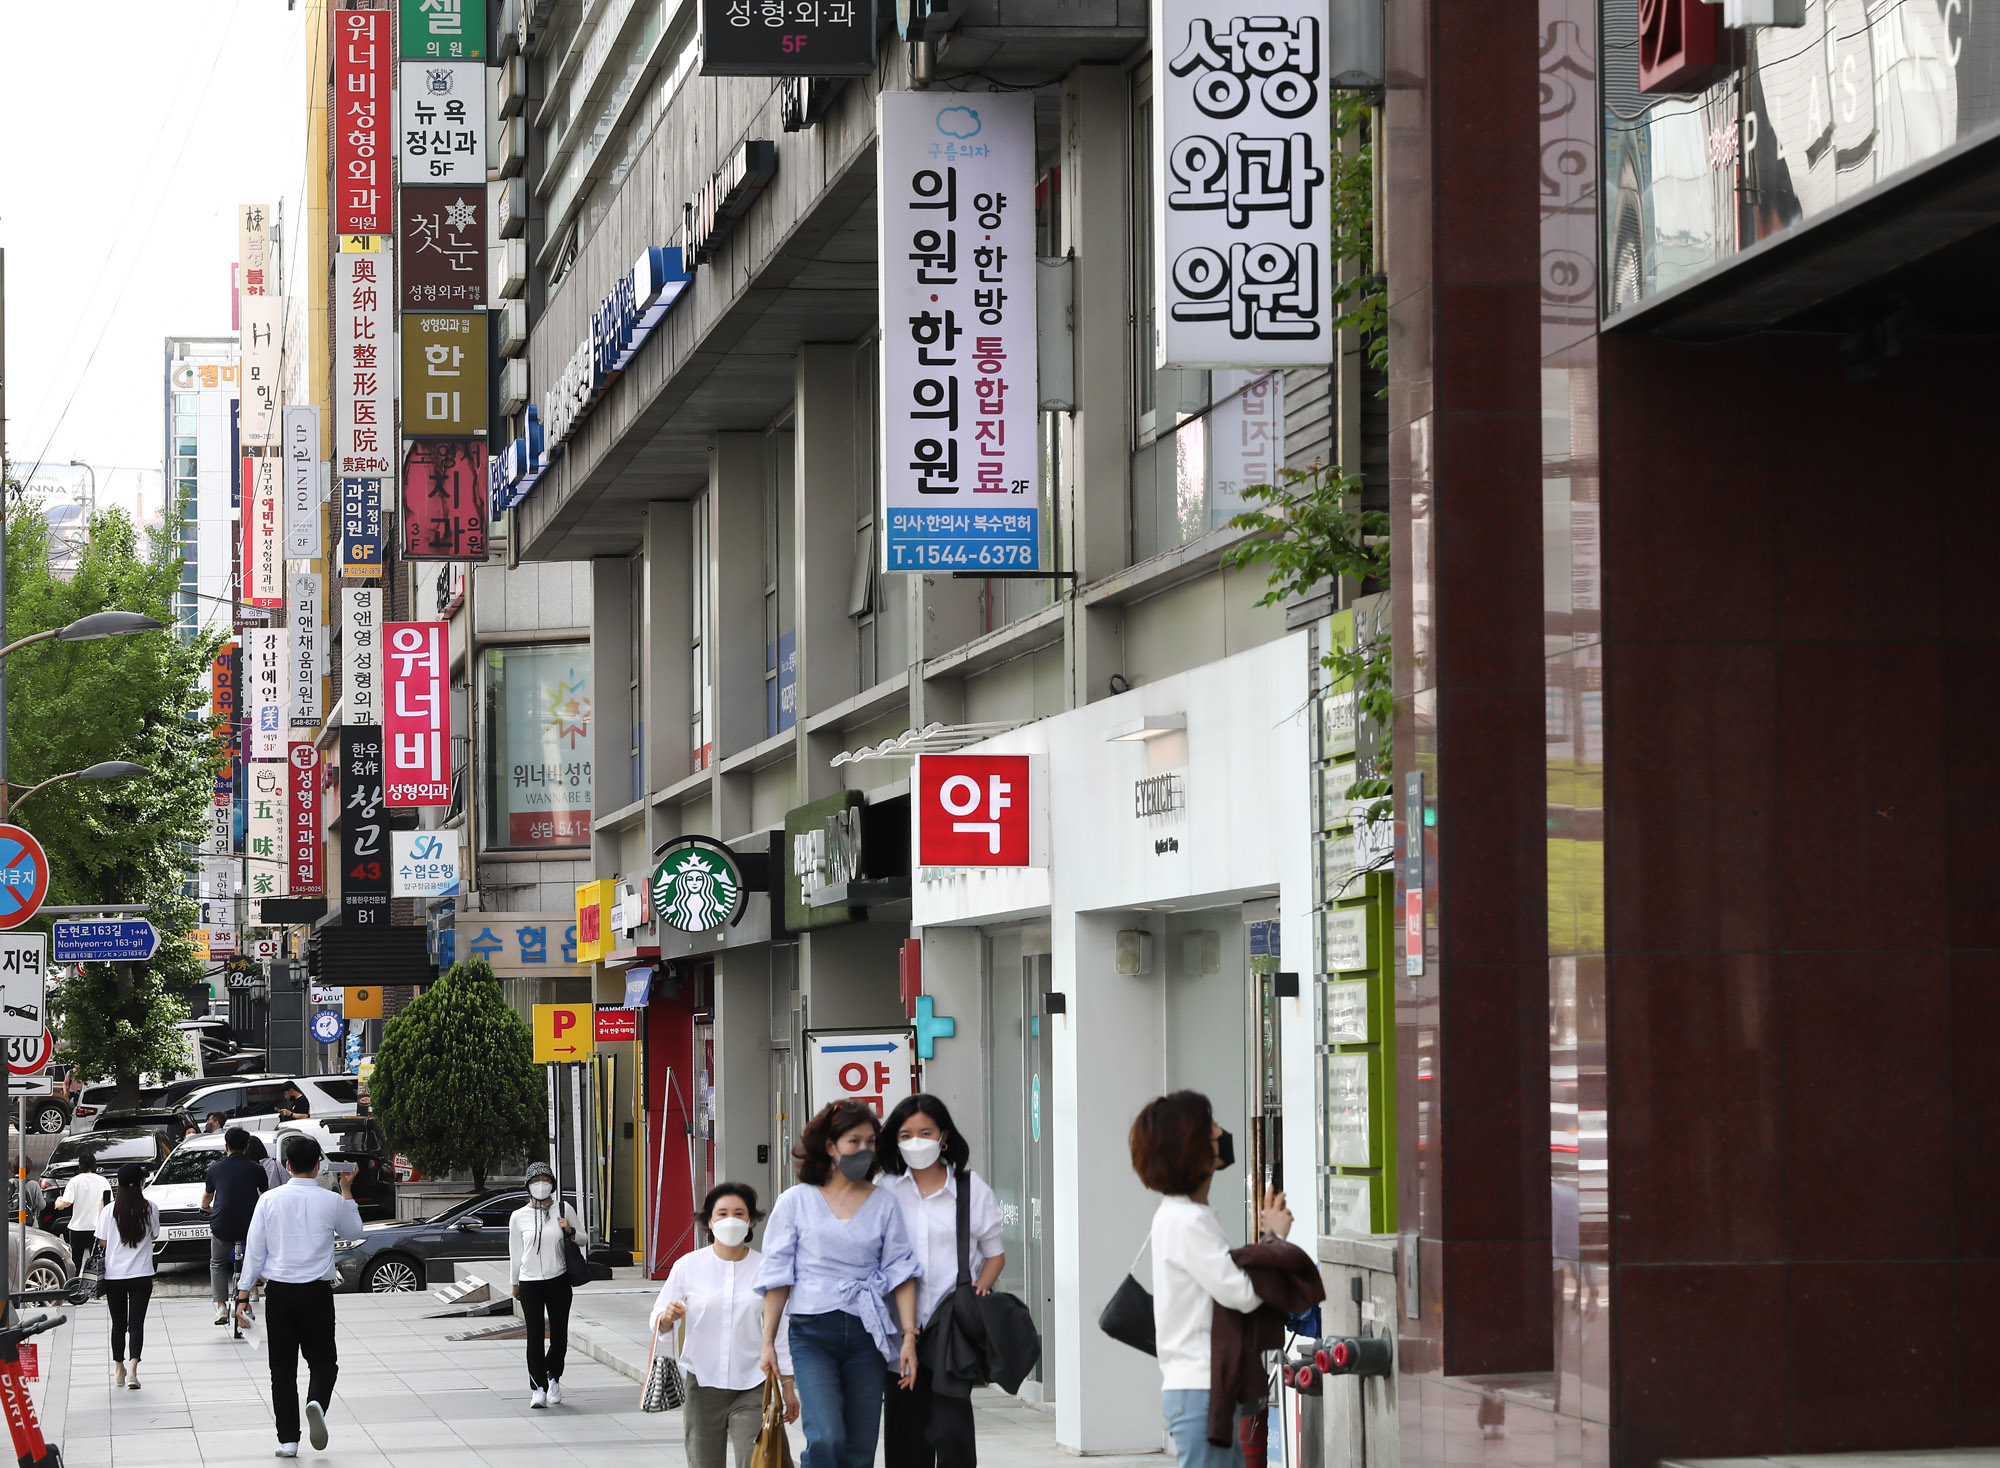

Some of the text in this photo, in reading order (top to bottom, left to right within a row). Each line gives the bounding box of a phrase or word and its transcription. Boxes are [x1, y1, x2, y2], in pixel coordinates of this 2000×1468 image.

[426, 42, 463, 57] 의원
[781, 35, 808, 53] 5F
[1169, 16, 1320, 120] 성형
[346, 15, 381, 215] 워너비성형외과
[414, 101, 467, 125] 뉴욕
[406, 131, 478, 156] 정신과
[927, 141, 991, 162] 구름의자
[429, 160, 455, 177] 5F
[1169, 132, 1325, 230] 외과
[349, 216, 378, 230] 의원
[408, 213, 480, 272] 첫눈
[408, 285, 467, 302] 성형외과
[1171, 242, 1321, 340] 의원
[420, 318, 460, 333] 성형외과
[351, 258, 378, 452] 奥纳比整形医院
[424, 343, 465, 423] 한미
[971, 336, 1009, 494] 통합진료
[296, 424, 307, 443] UP
[343, 457, 390, 473] 贵宾中心
[262, 462, 273, 496] 압구정
[296, 466, 308, 511] POINT
[1011, 480, 1030, 495] 2F
[345, 478, 364, 537] 과의원
[366, 478, 380, 537] 과교정과
[427, 470, 466, 555] 치과
[467, 516, 484, 555] 의원
[972, 514, 1032, 533] 복수면허
[297, 538, 309, 547] 2F
[351, 544, 375, 560] 6F
[892, 544, 1033, 566] T.1544-6378
[262, 539, 273, 585] 성형외과
[298, 600, 314, 704] 리앤채움의원
[353, 591, 374, 725] 영앤영 성형외과
[261, 634, 278, 702] 강남예일
[298, 706, 314, 716] 4F
[390, 627, 442, 781] 워너비
[263, 743, 277, 751] 3F
[351, 742, 379, 759] 한우
[351, 761, 379, 776] 名作
[387, 783, 449, 801] 성형외과
[525, 791, 581, 804] WANNABE
[1135, 772, 1173, 819] EYERICH
[346, 784, 383, 856] 창고
[939, 774, 1012, 855] 약
[529, 821, 554, 839] 상담
[253, 799, 274, 894] 五味家
[409, 835, 443, 860] Sh
[351, 861, 382, 880] 43
[400, 863, 455, 880] 수협은행
[358, 908, 375, 924] B1
[57, 924, 122, 938] 논현로163길
[57, 938, 143, 949] Nonhyeon-ro 163-gil
[3, 949, 40, 974] 지역
[553, 1010, 577, 1039] P
[8, 1037, 38, 1062] 30
[190, 1227, 209, 1238] 1851
[1, 1374, 25, 1429] DART
[18, 1375, 40, 1429] DART
